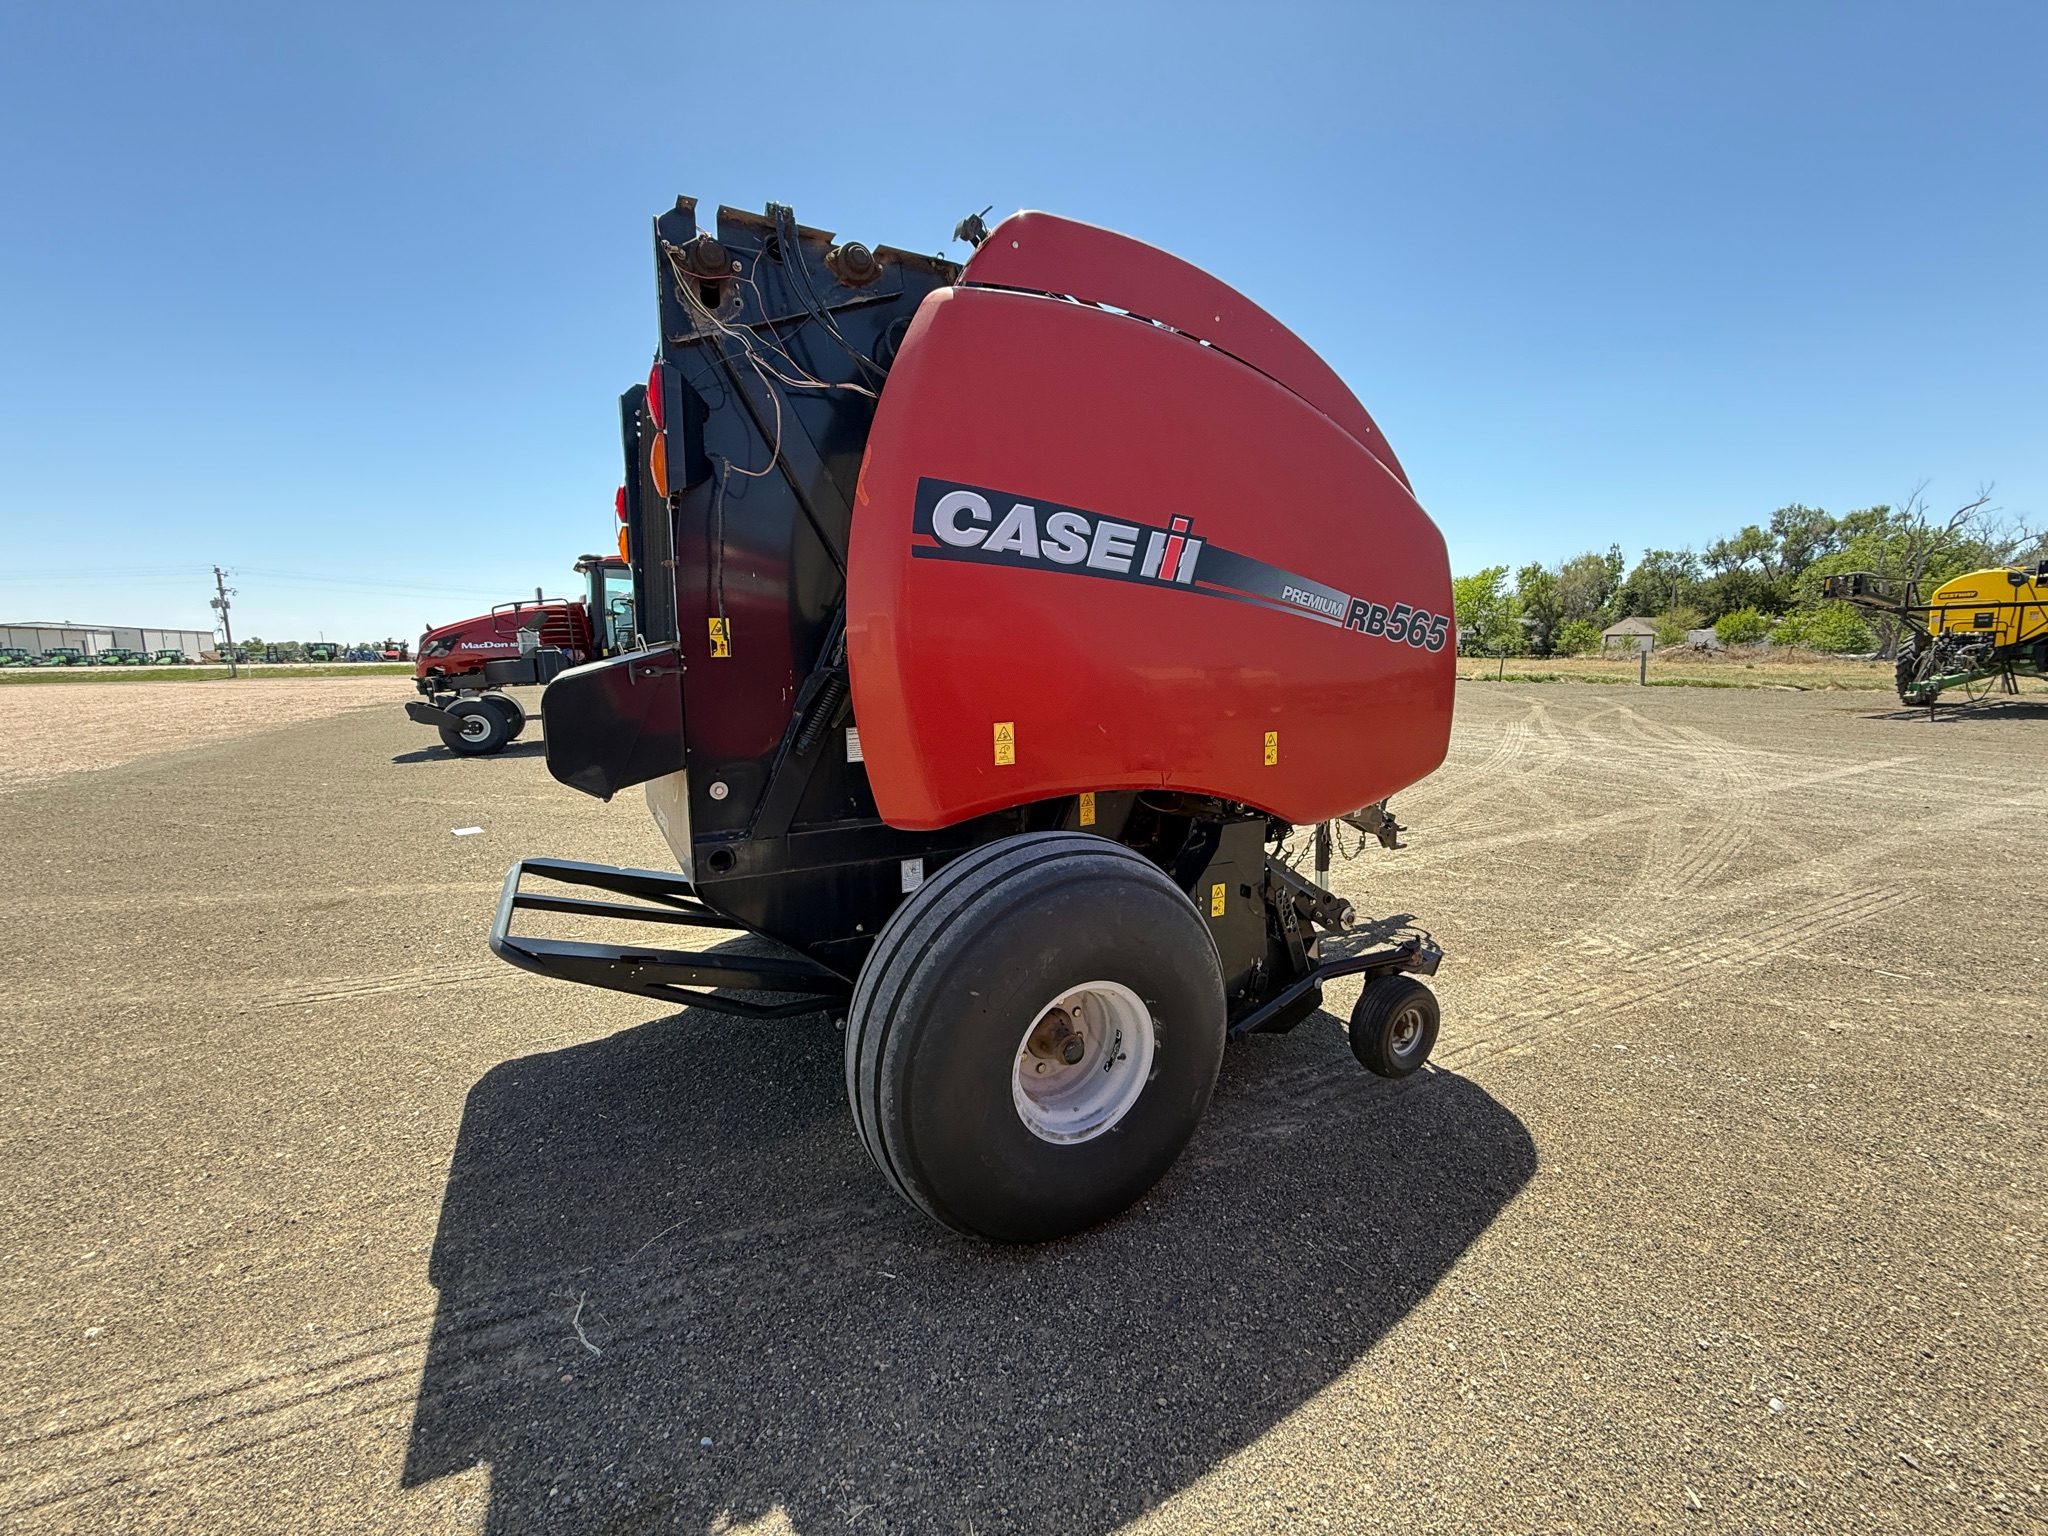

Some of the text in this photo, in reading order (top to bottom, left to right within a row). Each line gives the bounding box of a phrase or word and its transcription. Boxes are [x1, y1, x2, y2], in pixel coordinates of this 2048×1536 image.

[932, 490, 1140, 574] CASE
[461, 641, 508, 649] MacDon
[1281, 585, 1450, 653] PREMIUM RB565
